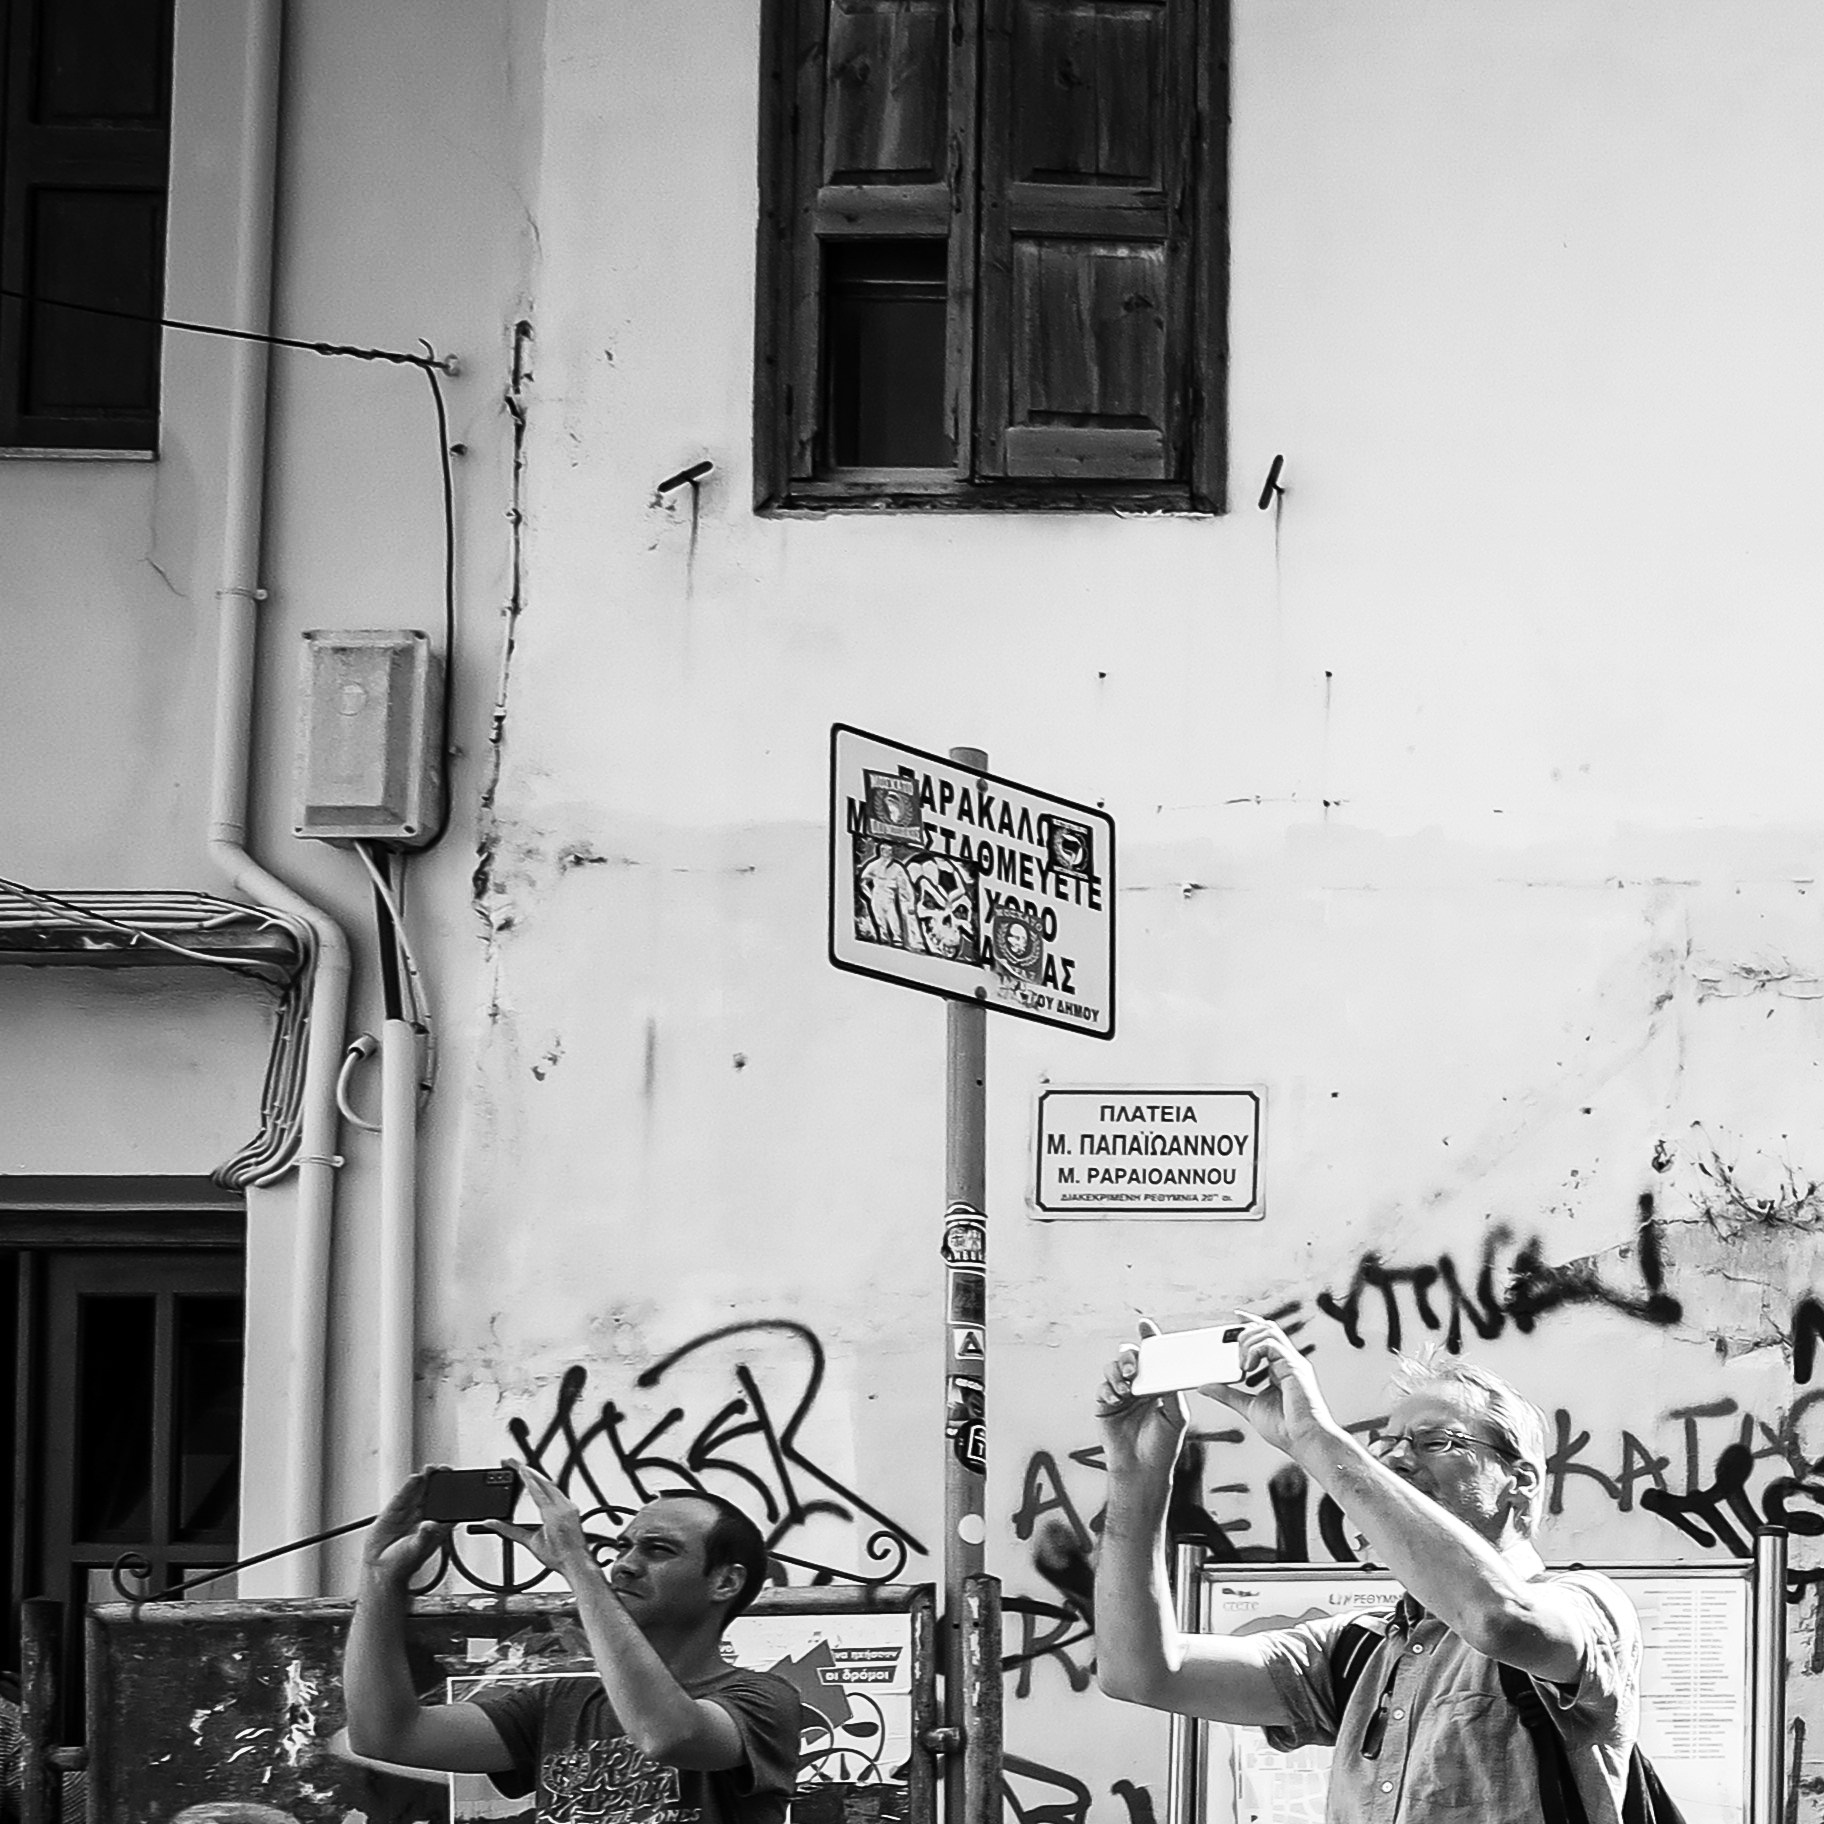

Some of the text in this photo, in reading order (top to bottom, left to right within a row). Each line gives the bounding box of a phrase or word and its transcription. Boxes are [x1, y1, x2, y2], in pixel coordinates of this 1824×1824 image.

[897, 764, 1050, 848] ΑΡΑΚΑΛΩ
[1057, 997, 1100, 1023] ΔΗΜΟΥ
[1100, 1105, 1197, 1123] ΠΛΑΤΕΙΑ
[1047, 1131, 1248, 1156] Μ. ΠΑΠΑΪΩΑΝΝΟΥ
[1058, 1168, 1236, 1185] M. PAPAIOANNOU
[825, 1668, 889, 1682] οι δρόμοι
